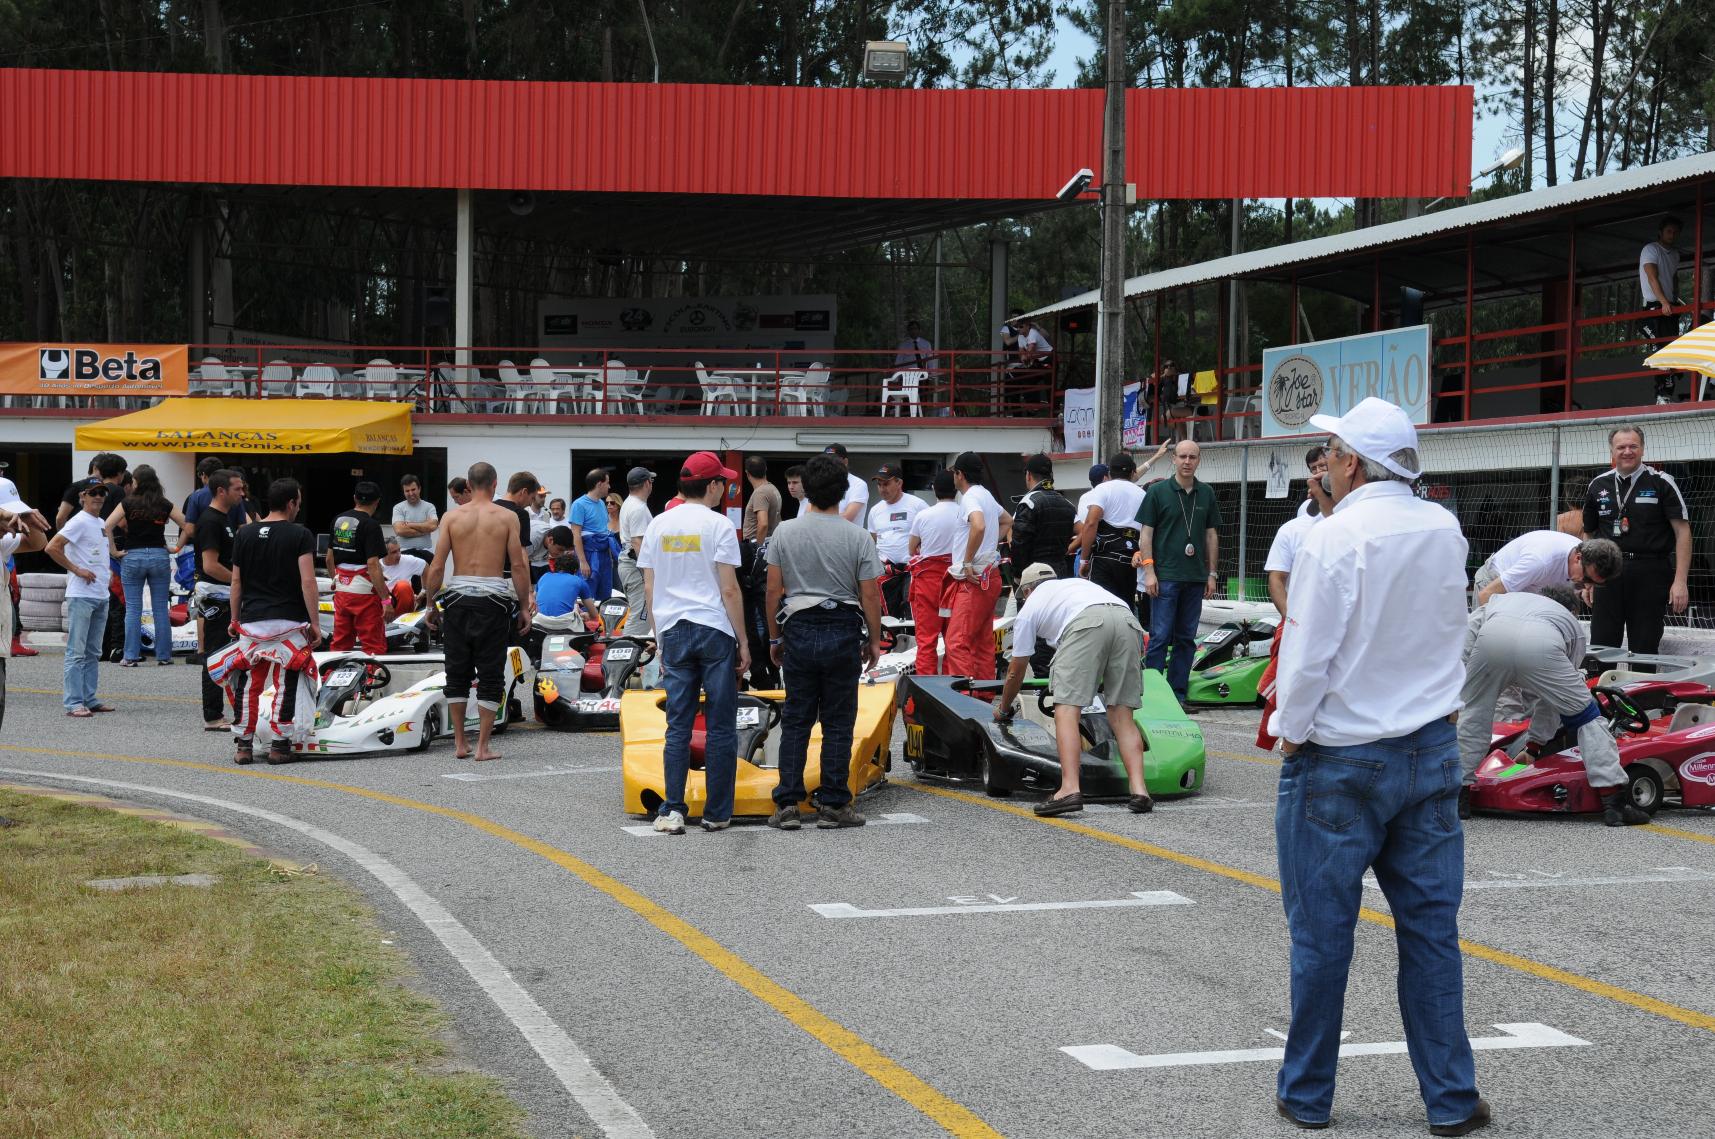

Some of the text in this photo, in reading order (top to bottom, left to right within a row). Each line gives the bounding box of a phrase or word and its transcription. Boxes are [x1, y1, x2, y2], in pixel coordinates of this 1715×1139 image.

[74, 349, 162, 381] Beta
[1328, 344, 1424, 414] VERÃO
[1285, 367, 1311, 409] Joe
[121, 440, 313, 451] www.pestronix.pt
